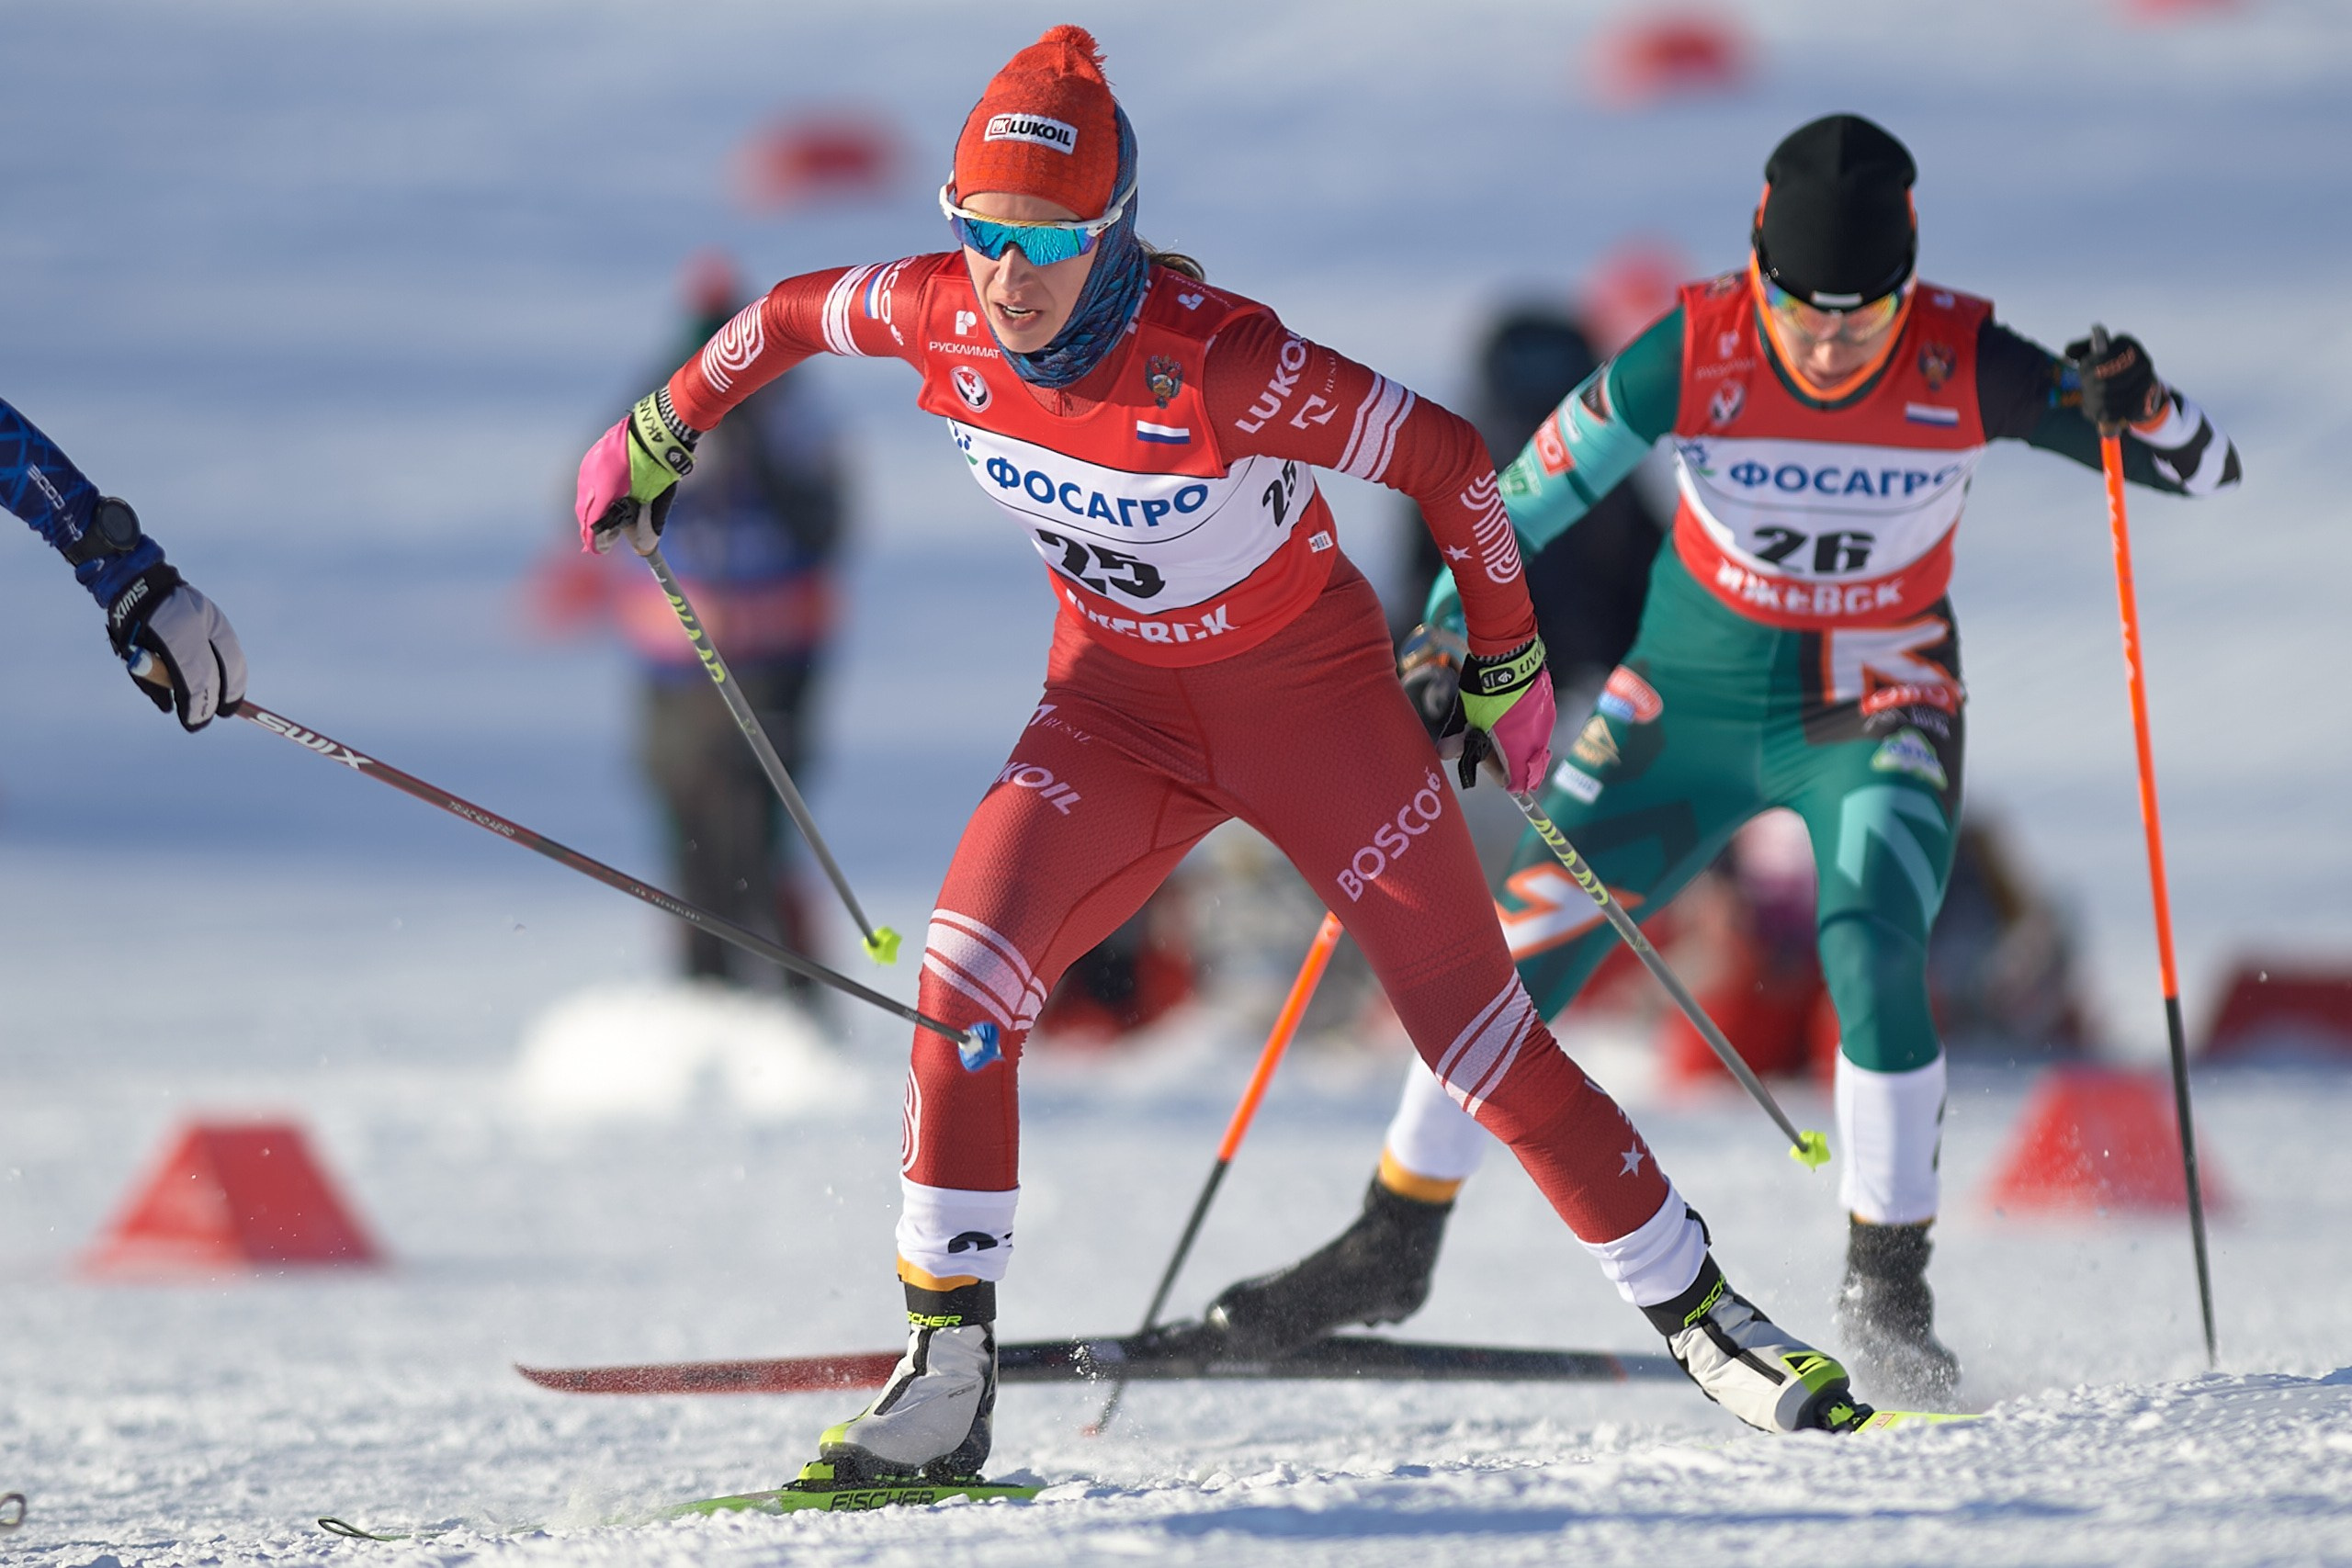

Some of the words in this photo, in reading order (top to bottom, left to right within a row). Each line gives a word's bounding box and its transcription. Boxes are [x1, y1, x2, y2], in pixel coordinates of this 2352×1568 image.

[1009, 120, 1072, 146] LUKOIL
[929, 341, 1001, 359] РУСКЛИМАТ
[28, 463, 65, 509] CODE
[986, 457, 1209, 527] ФОСАГРО
[1035, 528, 1167, 599] 25
[1753, 526, 1876, 574] 26
[111, 578, 149, 628] SWIX
[250, 711, 373, 771] SWIX
[1336, 786, 1442, 903] BOSCO
